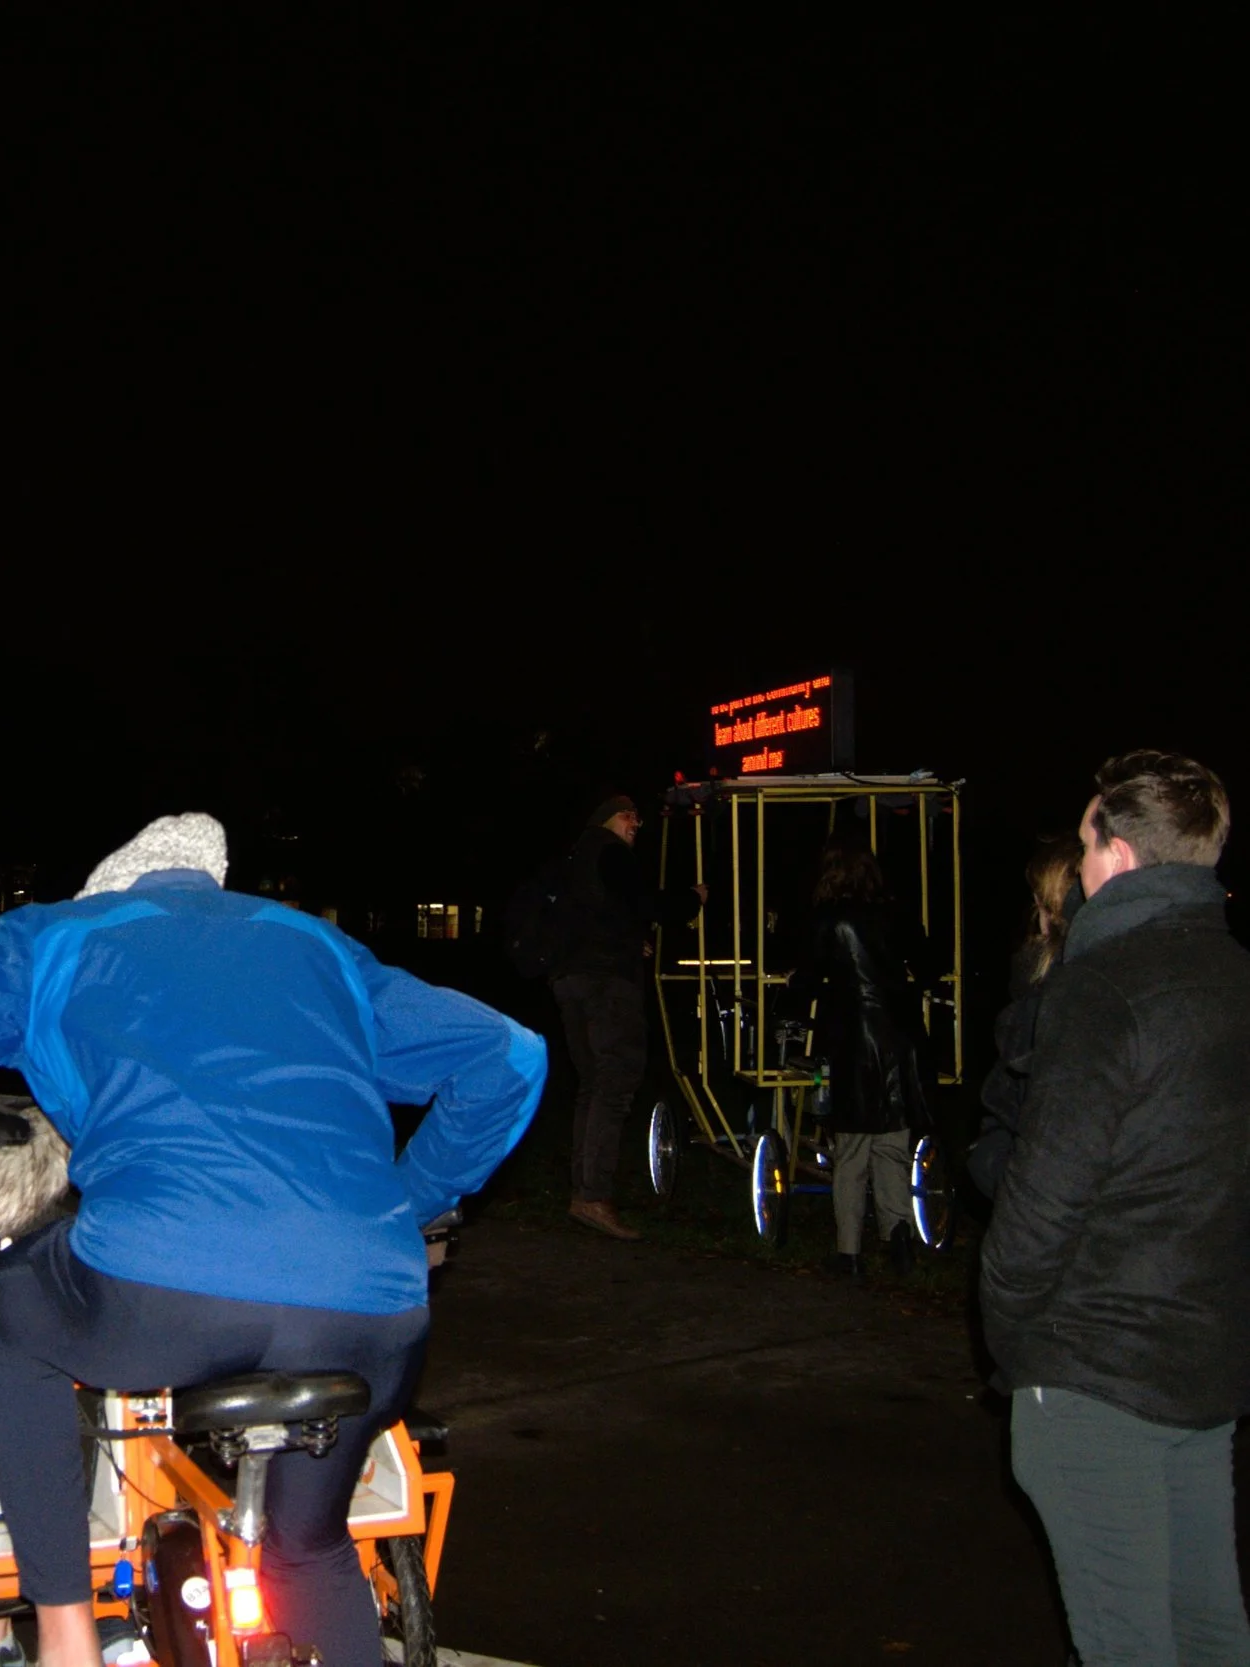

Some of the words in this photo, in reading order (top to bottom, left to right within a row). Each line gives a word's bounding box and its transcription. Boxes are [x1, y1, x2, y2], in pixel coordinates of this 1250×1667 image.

[734, 718, 753, 742] about
[754, 710, 786, 737] different
[787, 705, 820, 731] cultures
[742, 747, 767, 772] around
[769, 751, 783, 768] me
